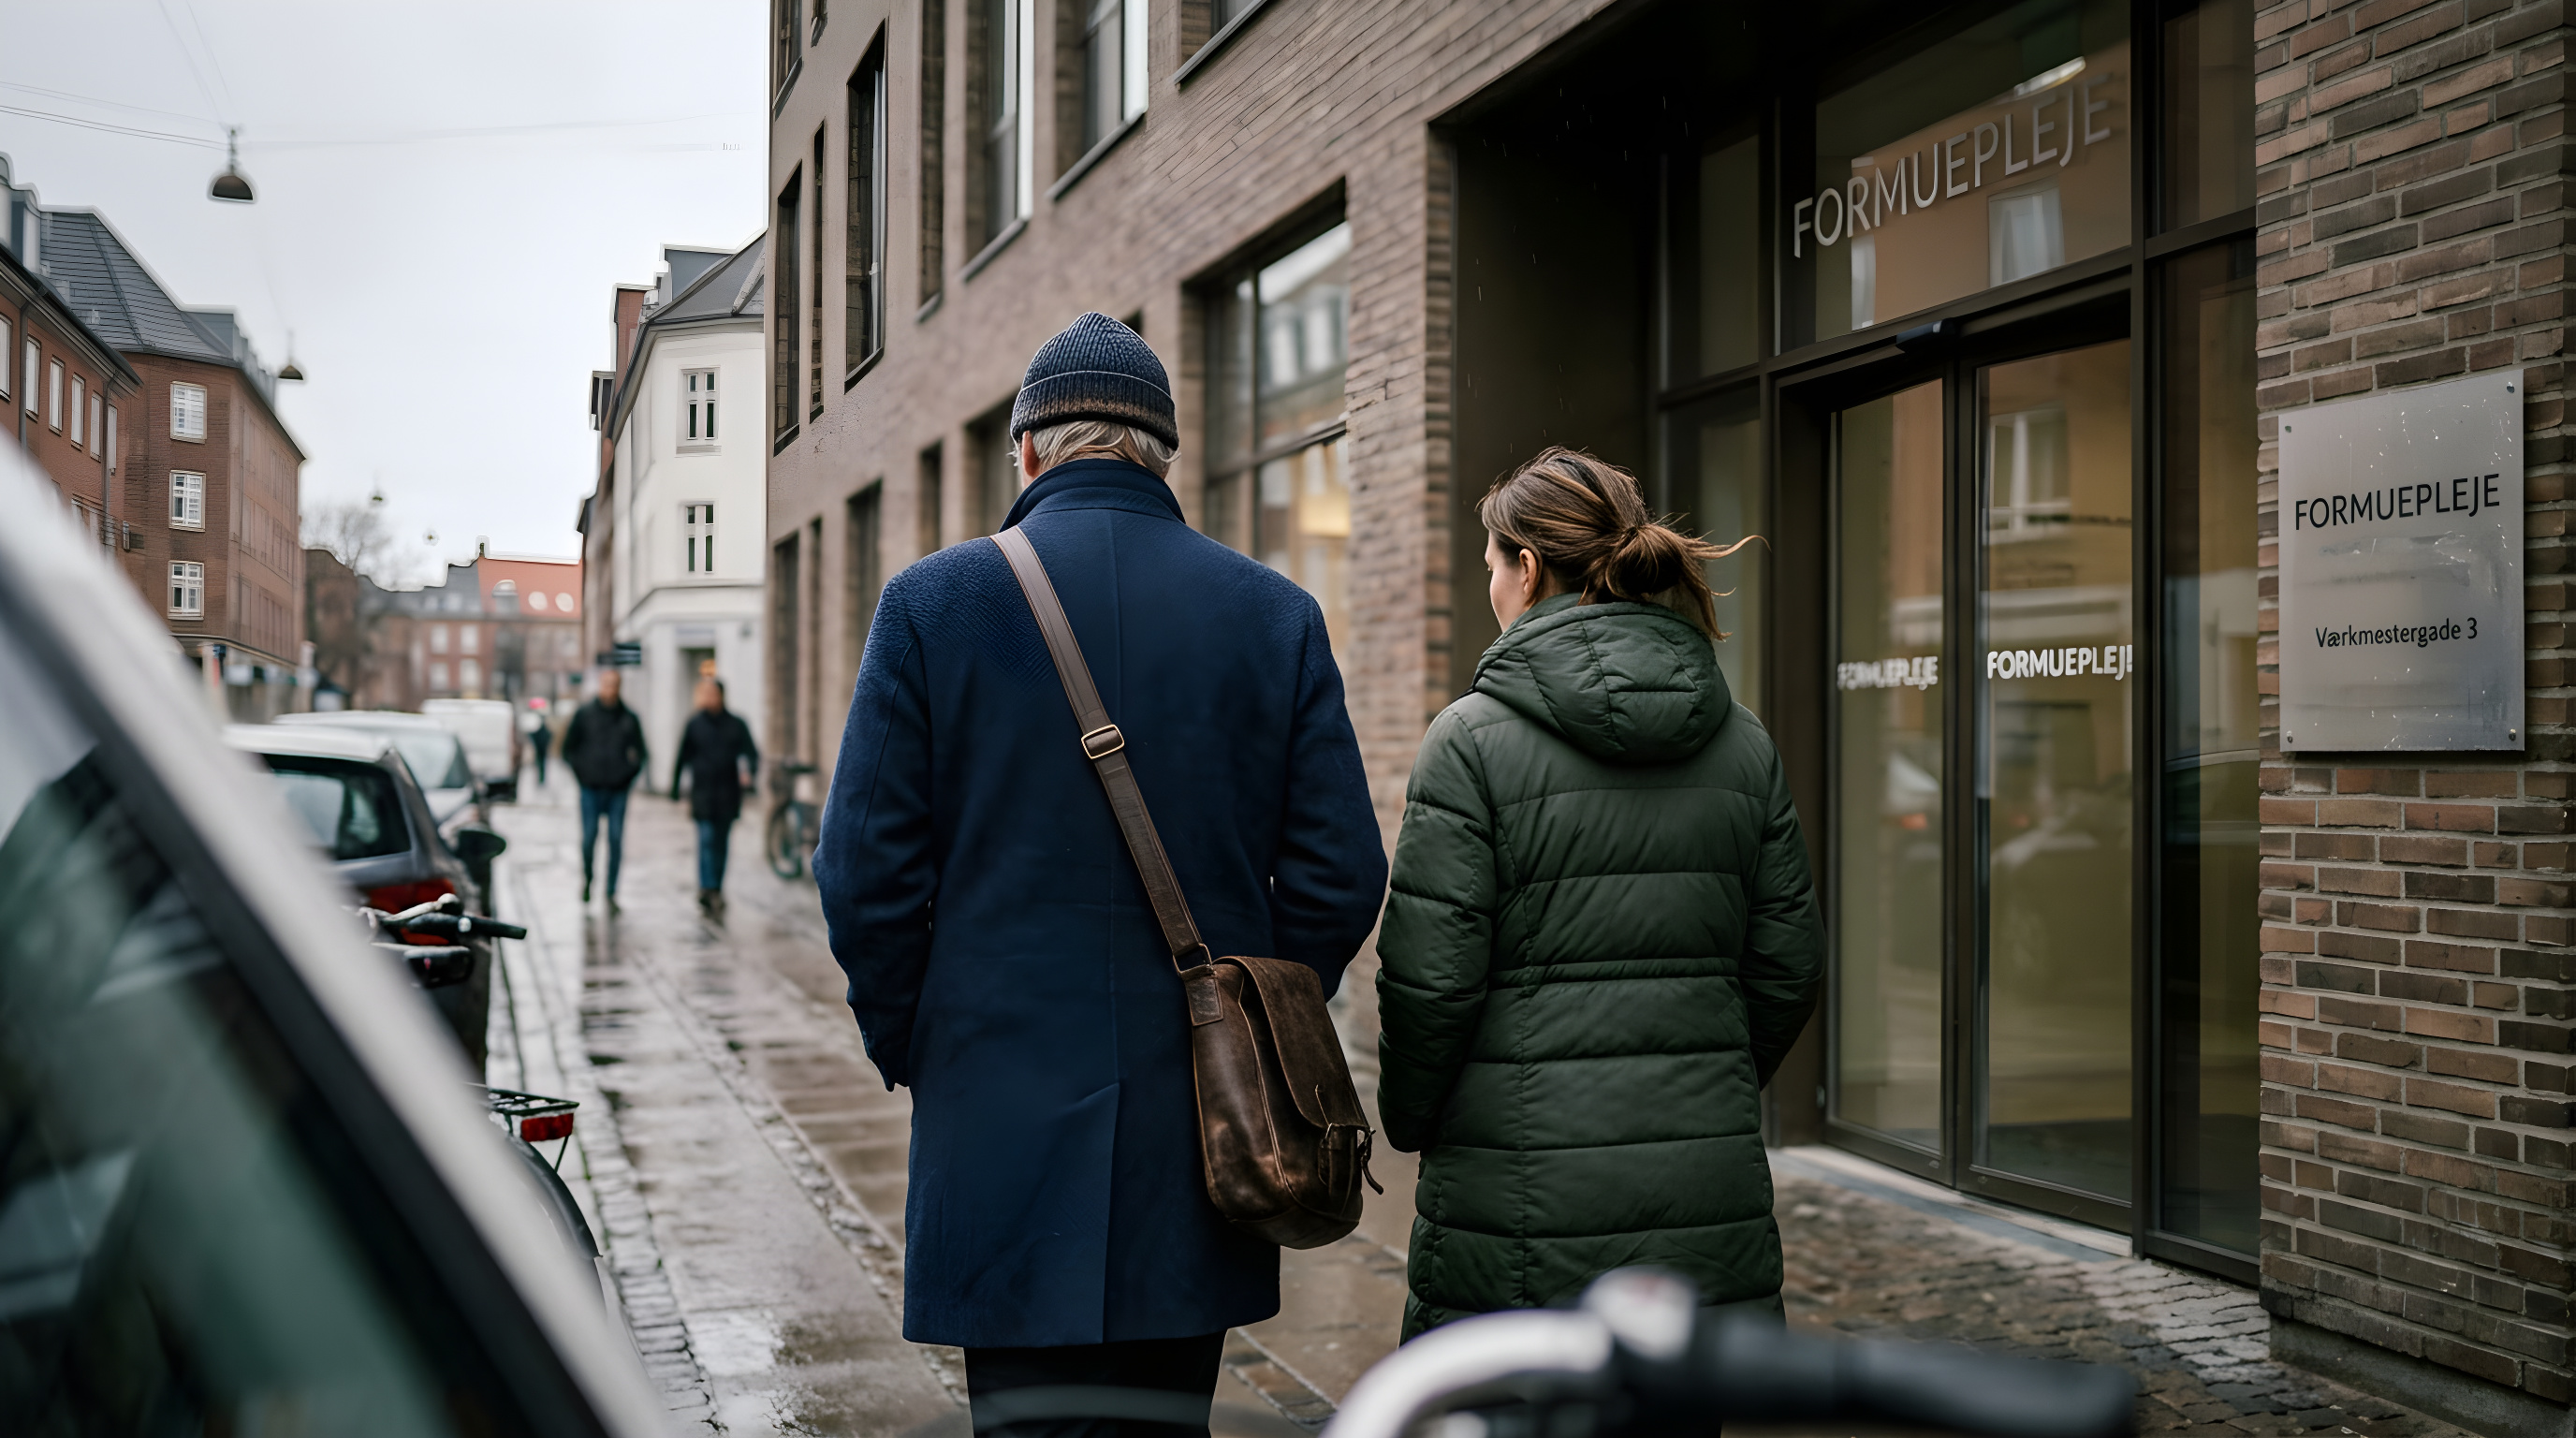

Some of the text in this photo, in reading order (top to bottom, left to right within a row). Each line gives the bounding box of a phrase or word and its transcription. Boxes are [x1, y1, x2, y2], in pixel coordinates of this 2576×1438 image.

[1793, 72, 2112, 258] FORMUEPLEJE
[2294, 473, 2501, 531] FORMUEPLEJE
[2315, 617, 2479, 648] Værkmestergade 3
